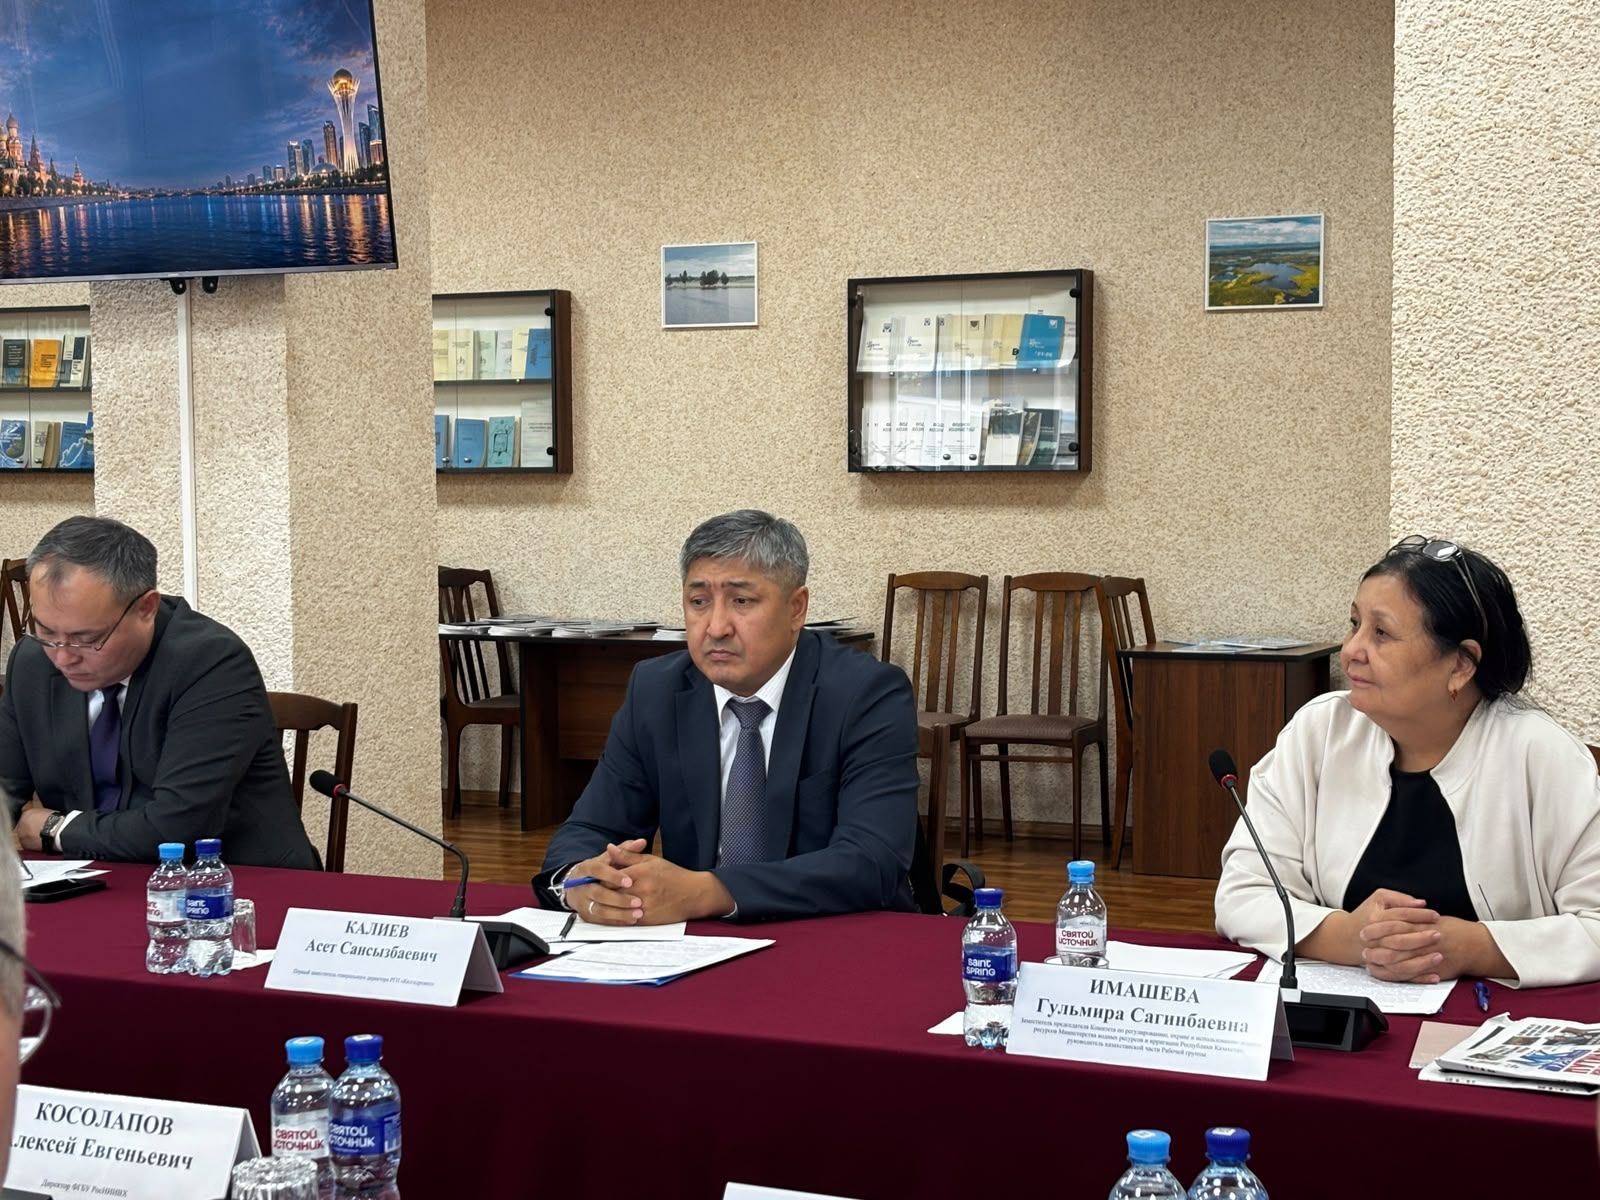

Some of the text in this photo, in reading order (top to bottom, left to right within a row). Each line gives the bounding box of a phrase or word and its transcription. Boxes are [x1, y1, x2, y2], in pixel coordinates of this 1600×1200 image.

[344, 920, 410, 939] КАЛИЕВ
[1058, 937, 1098, 947] ИСТОЧНИК
[1061, 929, 1094, 938] СВЯТОЙ
[305, 939, 438, 964] Асет Сансызбаевич
[1090, 978, 1200, 1004] ИМАШЕВА
[1036, 998, 1249, 1033] Гульмира Сагинбаевна
[34, 1102, 174, 1136] КОСОЛАПОВ
[10, 1134, 194, 1170] лексей Евгеньевич
[328, 1134, 376, 1148] СТОЧНИК
